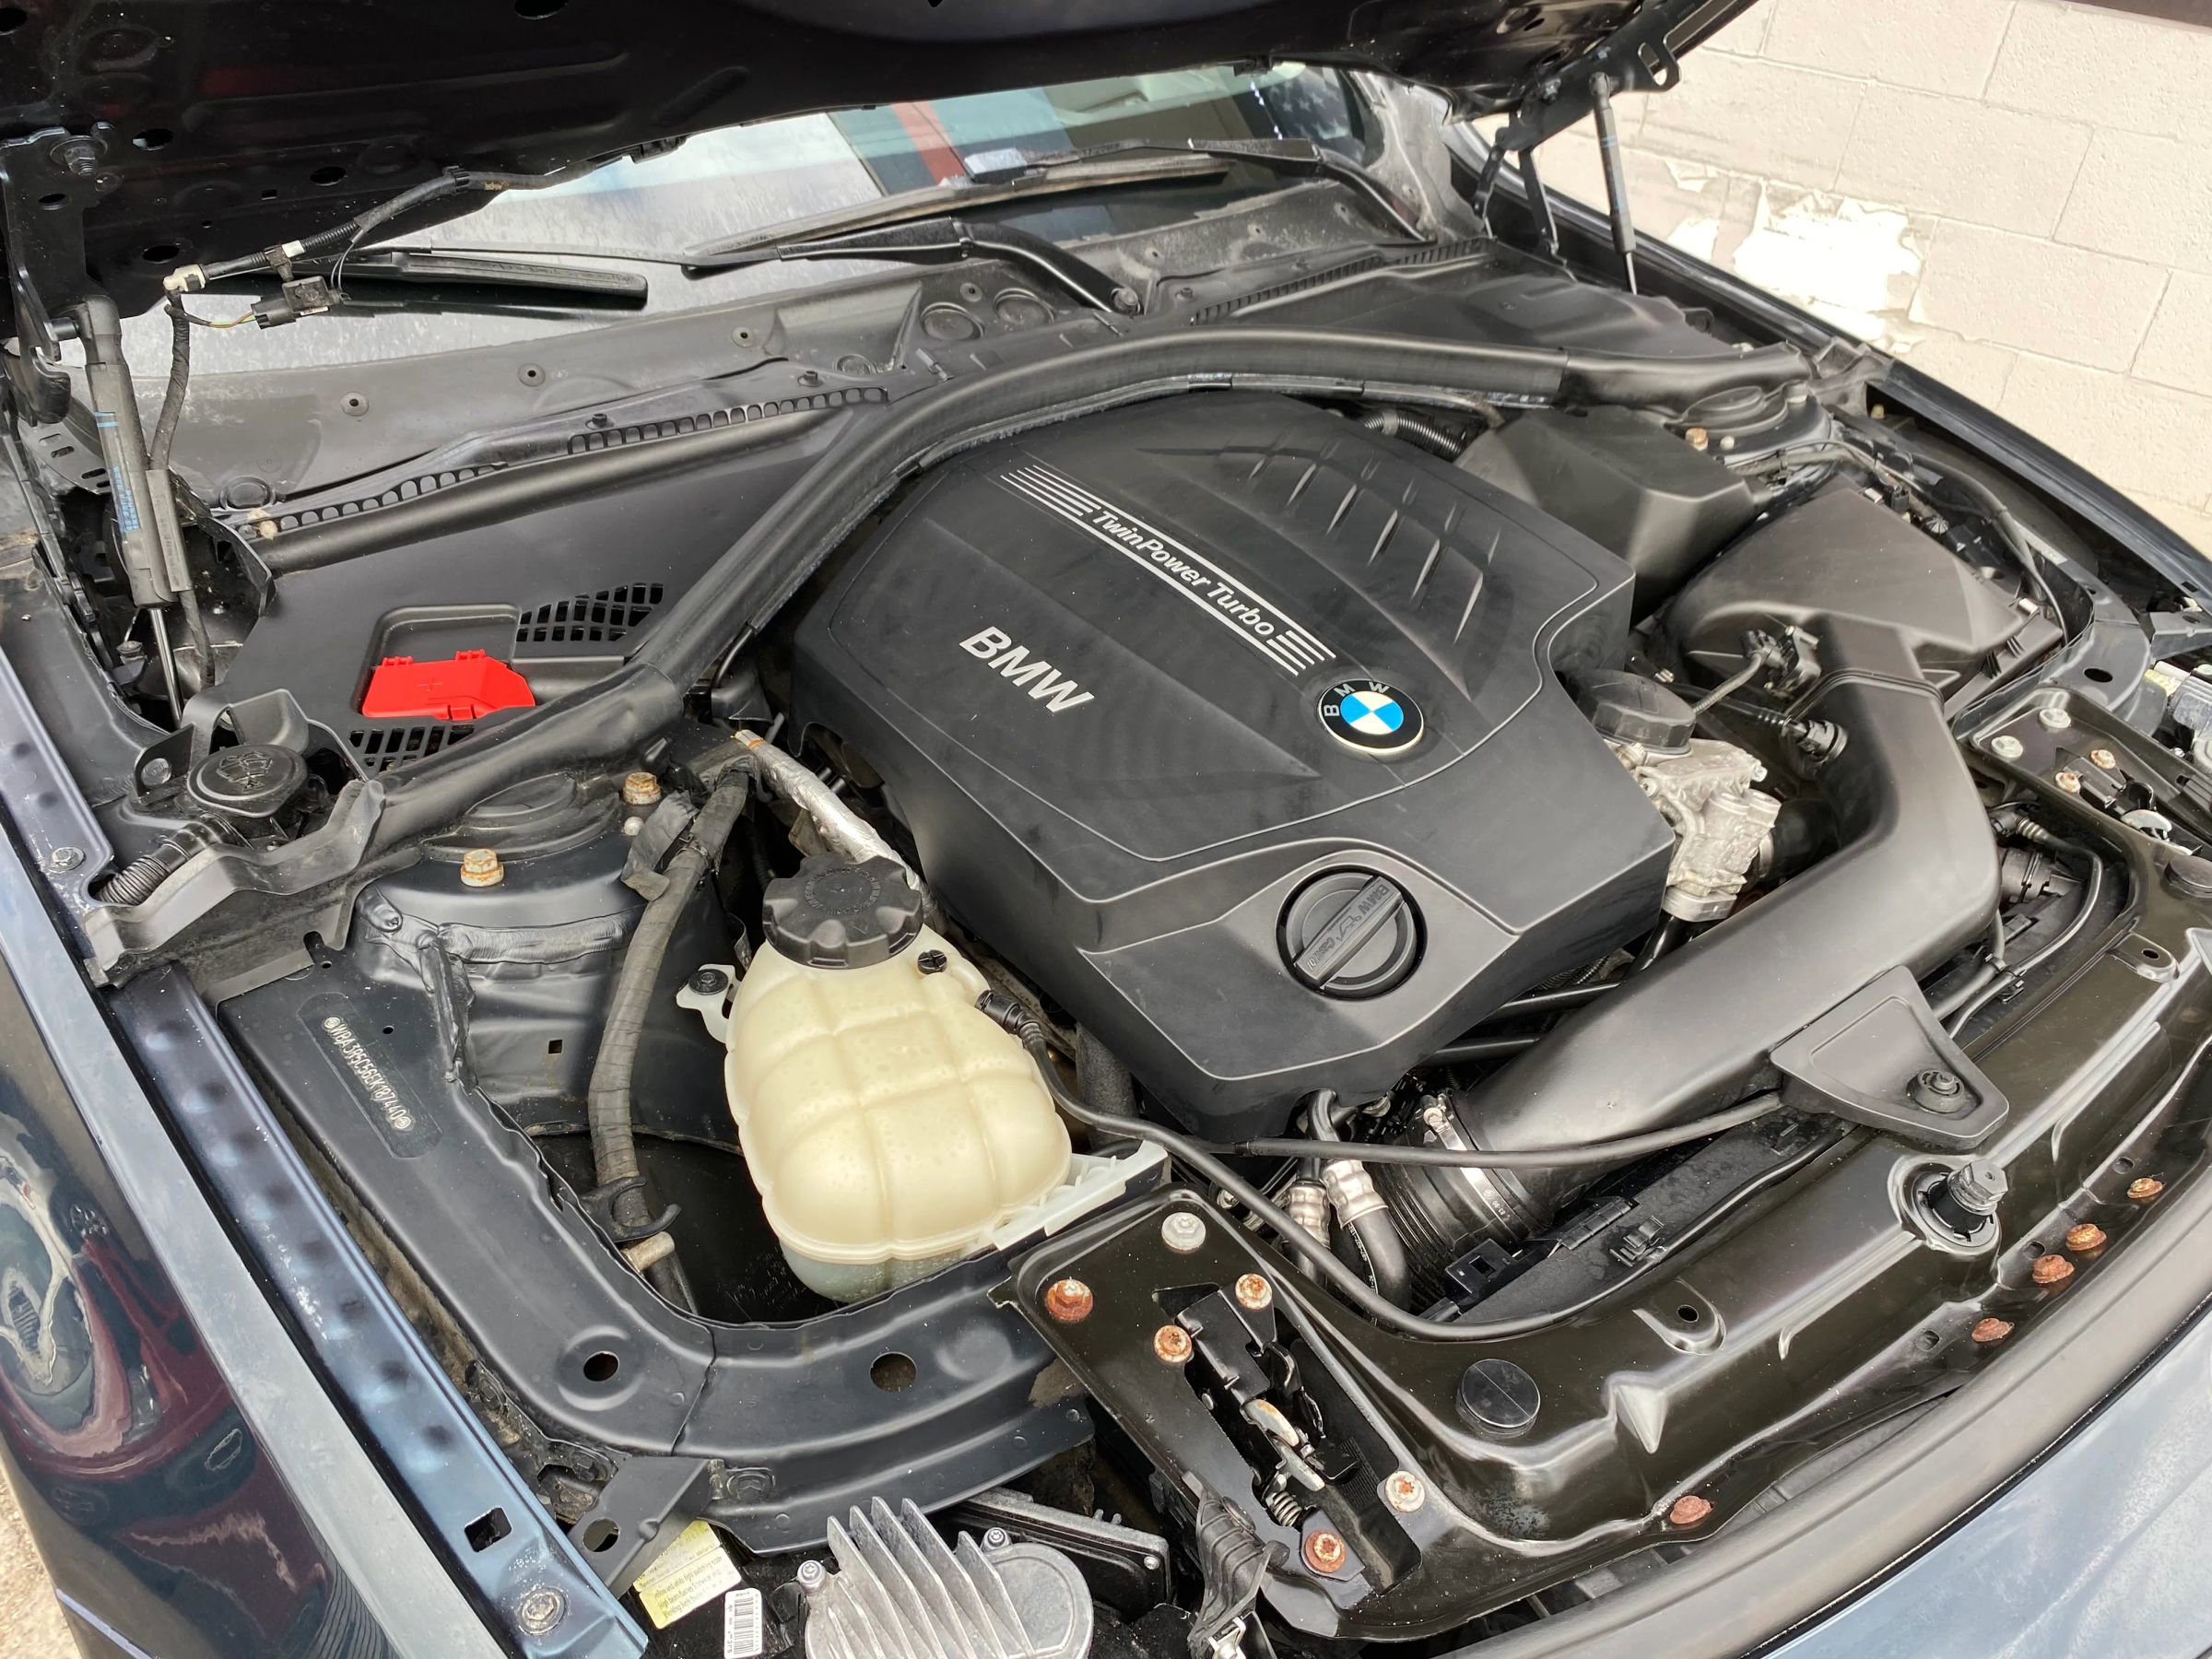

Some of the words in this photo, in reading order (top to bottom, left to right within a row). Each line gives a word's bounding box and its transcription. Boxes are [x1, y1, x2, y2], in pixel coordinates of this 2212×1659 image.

[1091, 510, 1211, 587] TwinPower
[1206, 582, 1275, 635] Turbo
[959, 626, 1095, 712] BMW
[1323, 681, 1390, 716] BMW
[1358, 884, 1390, 914] BMW
